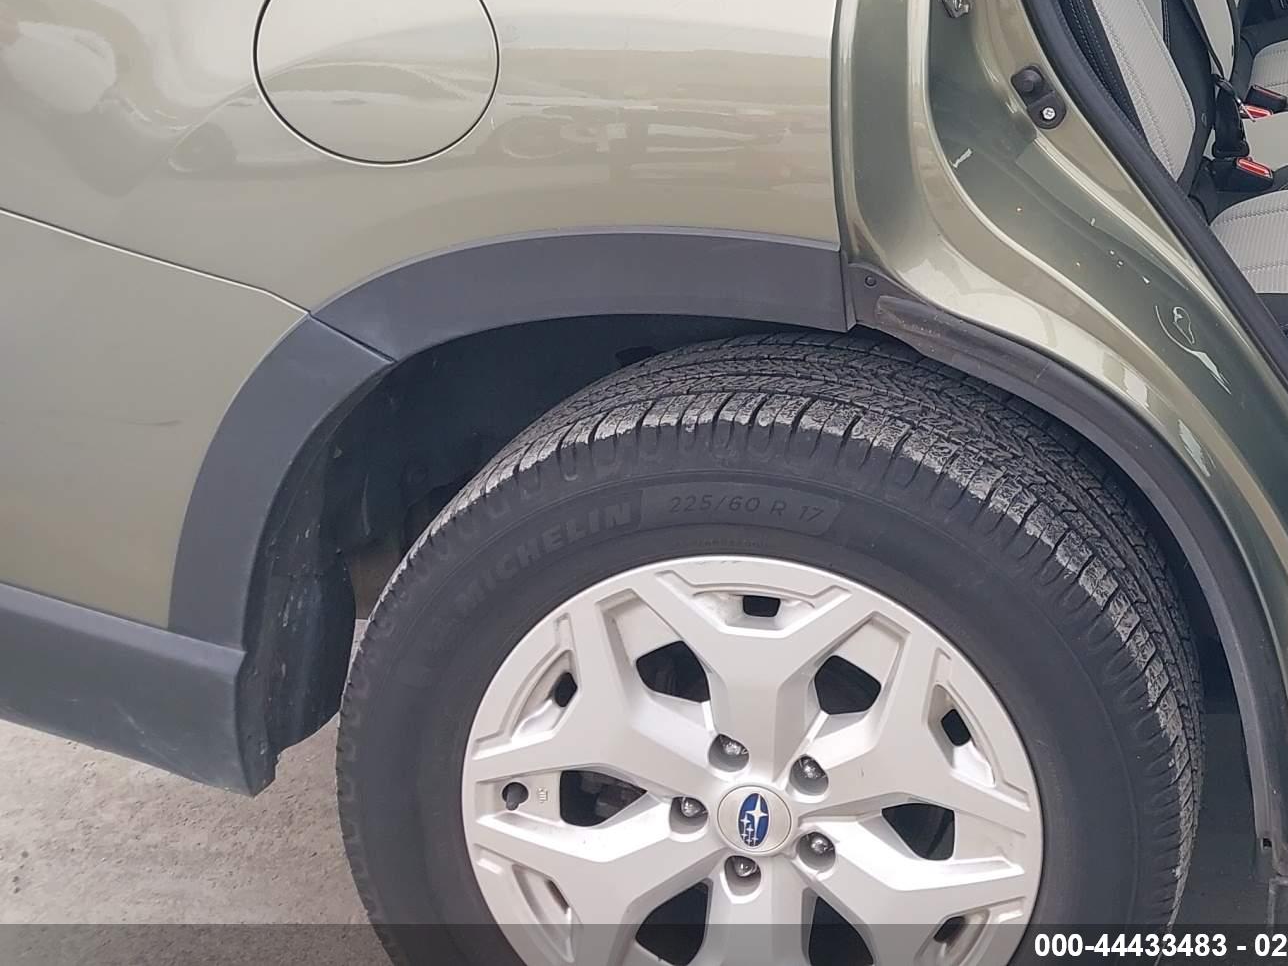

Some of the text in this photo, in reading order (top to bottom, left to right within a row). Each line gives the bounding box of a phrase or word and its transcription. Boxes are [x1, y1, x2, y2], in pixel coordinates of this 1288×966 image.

[669, 494, 825, 523] 225/60 R 17
[454, 500, 632, 611] MICHELIN
